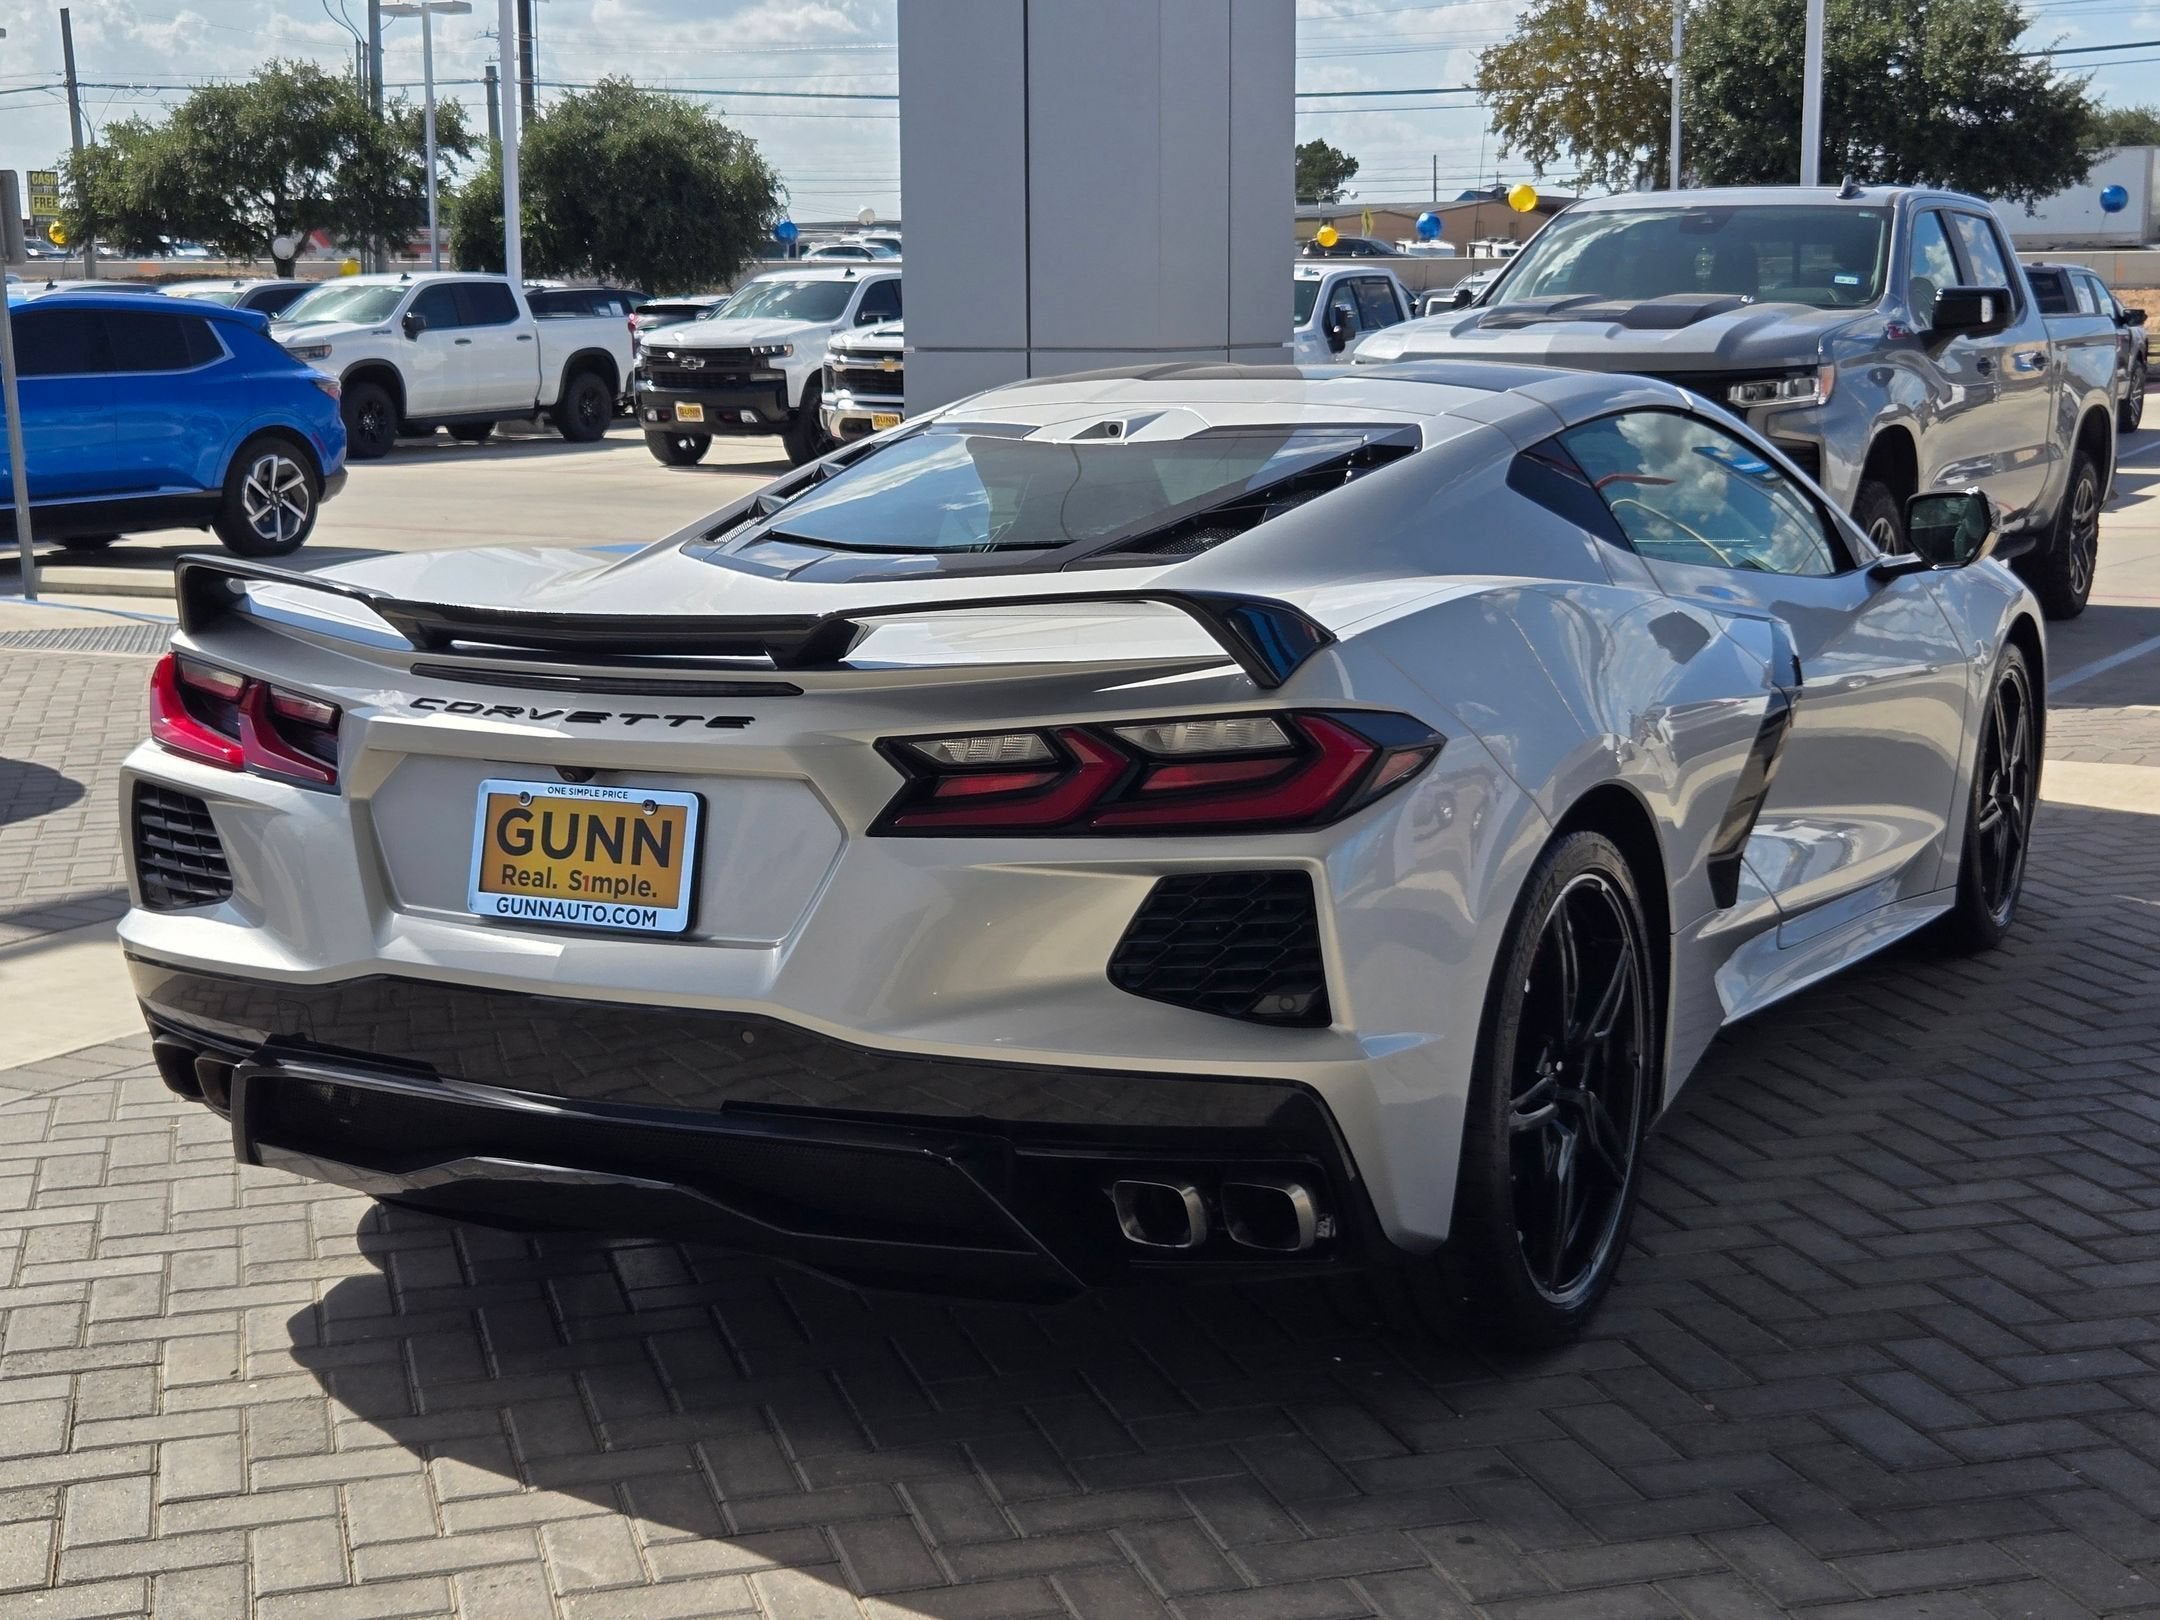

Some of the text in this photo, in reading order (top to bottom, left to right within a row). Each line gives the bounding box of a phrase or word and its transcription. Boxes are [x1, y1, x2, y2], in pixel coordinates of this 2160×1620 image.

[32, 172, 57, 185] CASH
[34, 196, 58, 208] FREE
[409, 697, 756, 729] CORVETTE
[547, 786, 628, 800] ONE SIMPLE PRICE
[496, 808, 672, 868] GUNN
[501, 864, 557, 889] Real.
[496, 896, 657, 927] GUNNAUTO.COM
